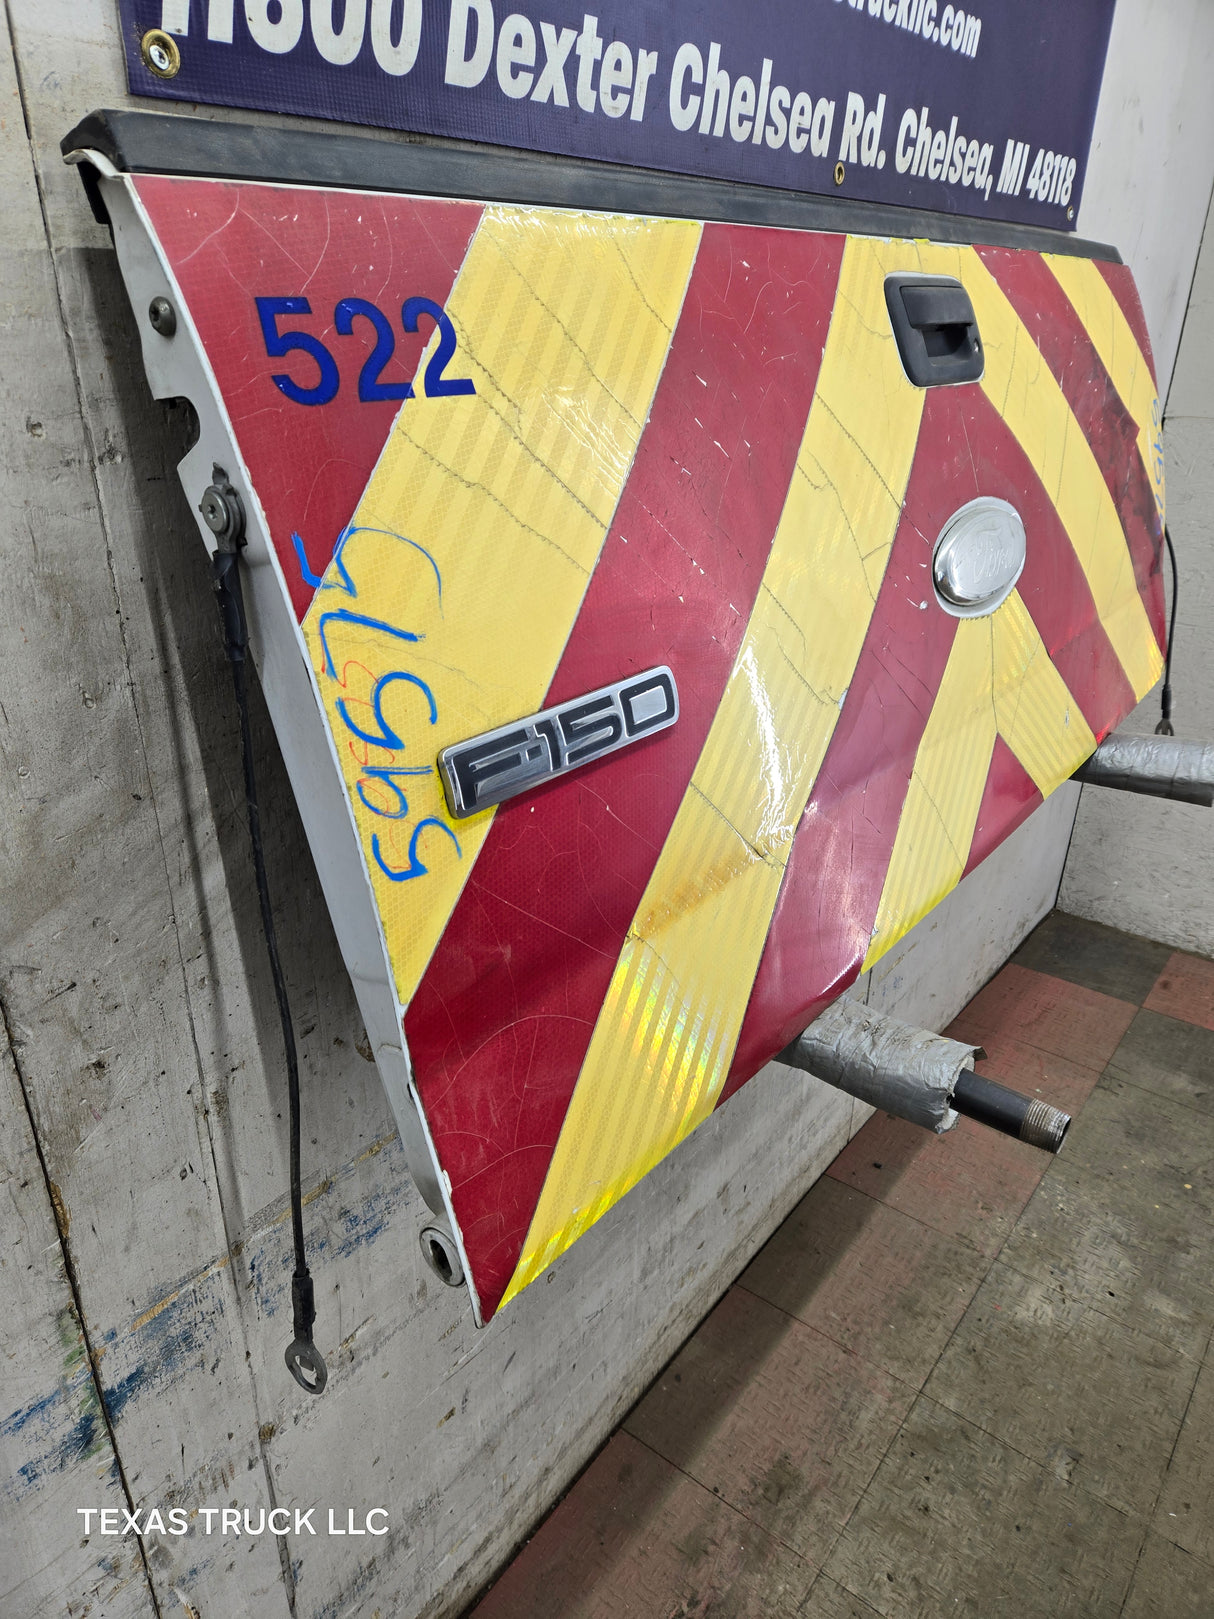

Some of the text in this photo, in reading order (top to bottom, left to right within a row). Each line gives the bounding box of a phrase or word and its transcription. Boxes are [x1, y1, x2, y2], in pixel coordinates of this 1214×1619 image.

[444, 0, 658, 122] Dexter
[669, 41, 836, 158] Chelsea
[838, 91, 887, 169] Rd.
[895, 106, 994, 201] Chelsea,
[997, 138, 1031, 199] MI
[1026, 148, 1077, 207] 48118
[254, 296, 477, 407] 522
[290, 526, 462, 882] 59575
